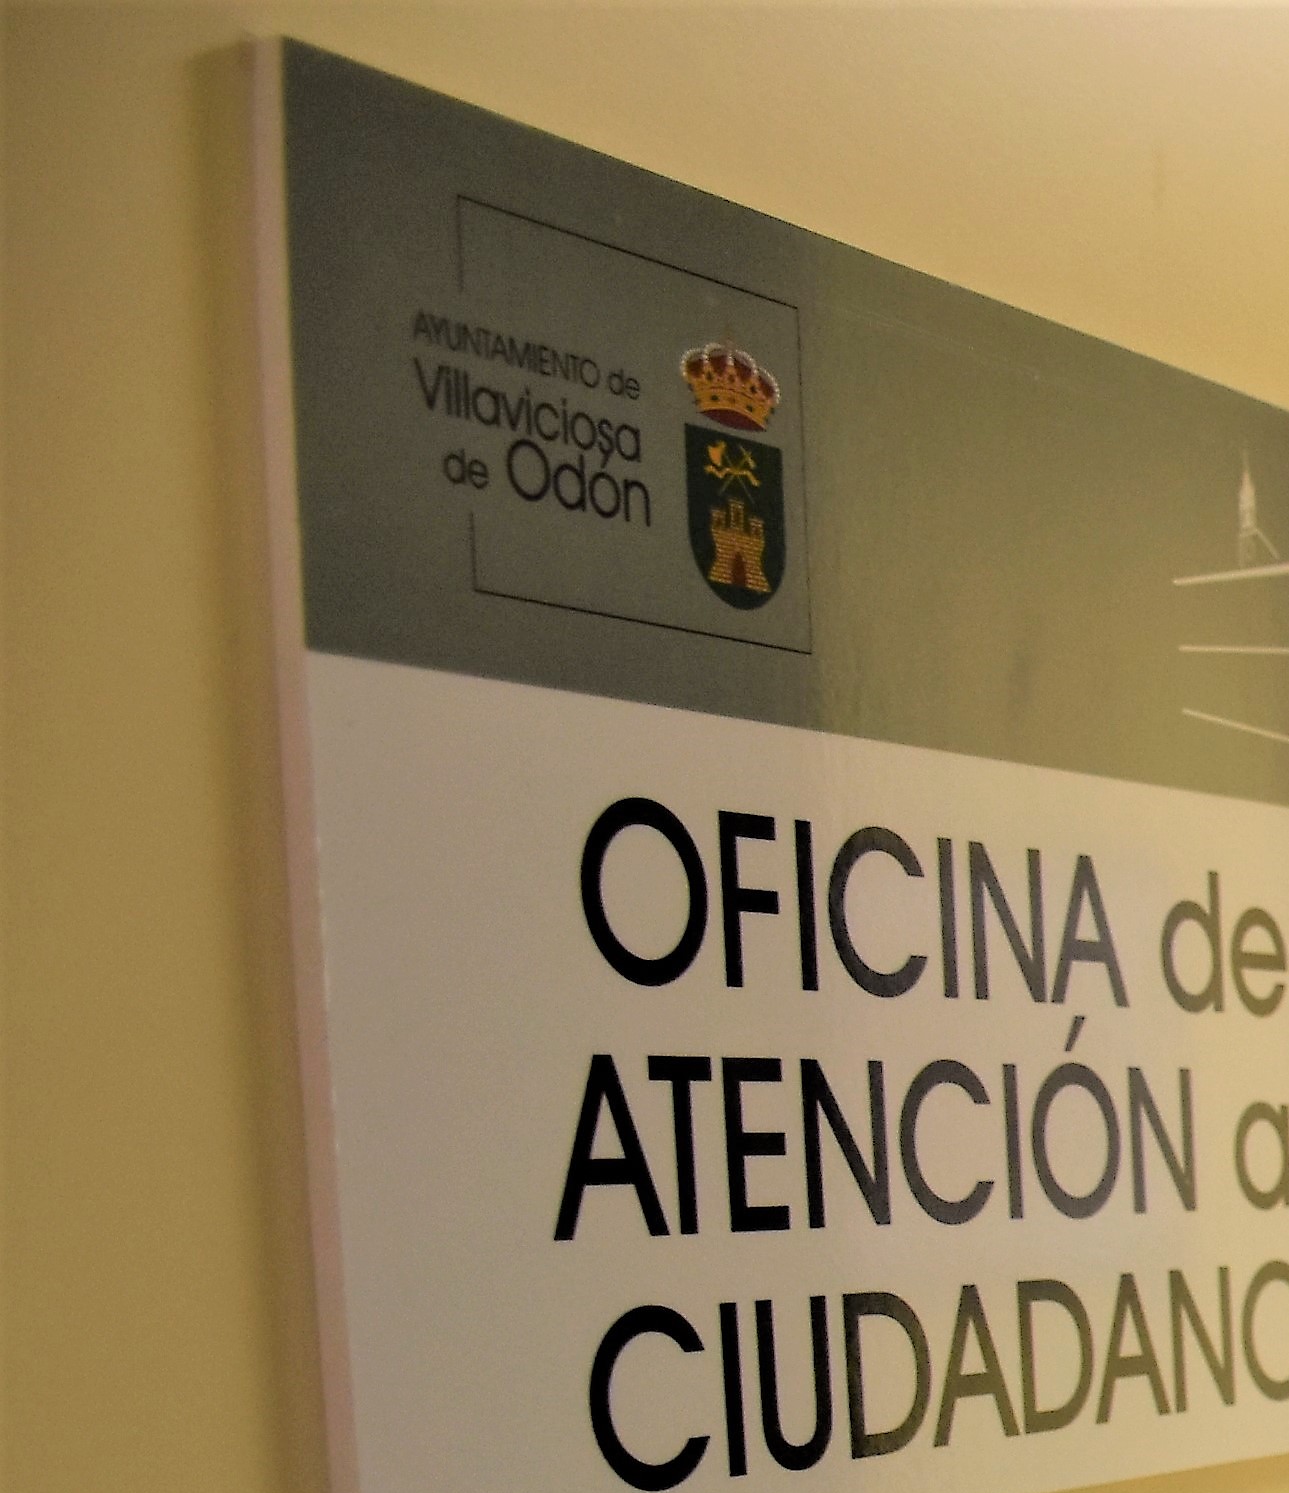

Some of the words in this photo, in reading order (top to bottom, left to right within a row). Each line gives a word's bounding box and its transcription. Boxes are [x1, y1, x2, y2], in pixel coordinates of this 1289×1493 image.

[412, 309, 599, 390] AYUNTAMIENTO
[608, 368, 641, 400] de
[413, 357, 642, 463] Villaviciosa
[443, 448, 490, 490] de
[507, 437, 651, 527] Odón
[579, 796, 1130, 1008] OFICINA
[1161, 870, 1288, 1018] de
[553, 1015, 1197, 1241] ATENCIÓN
